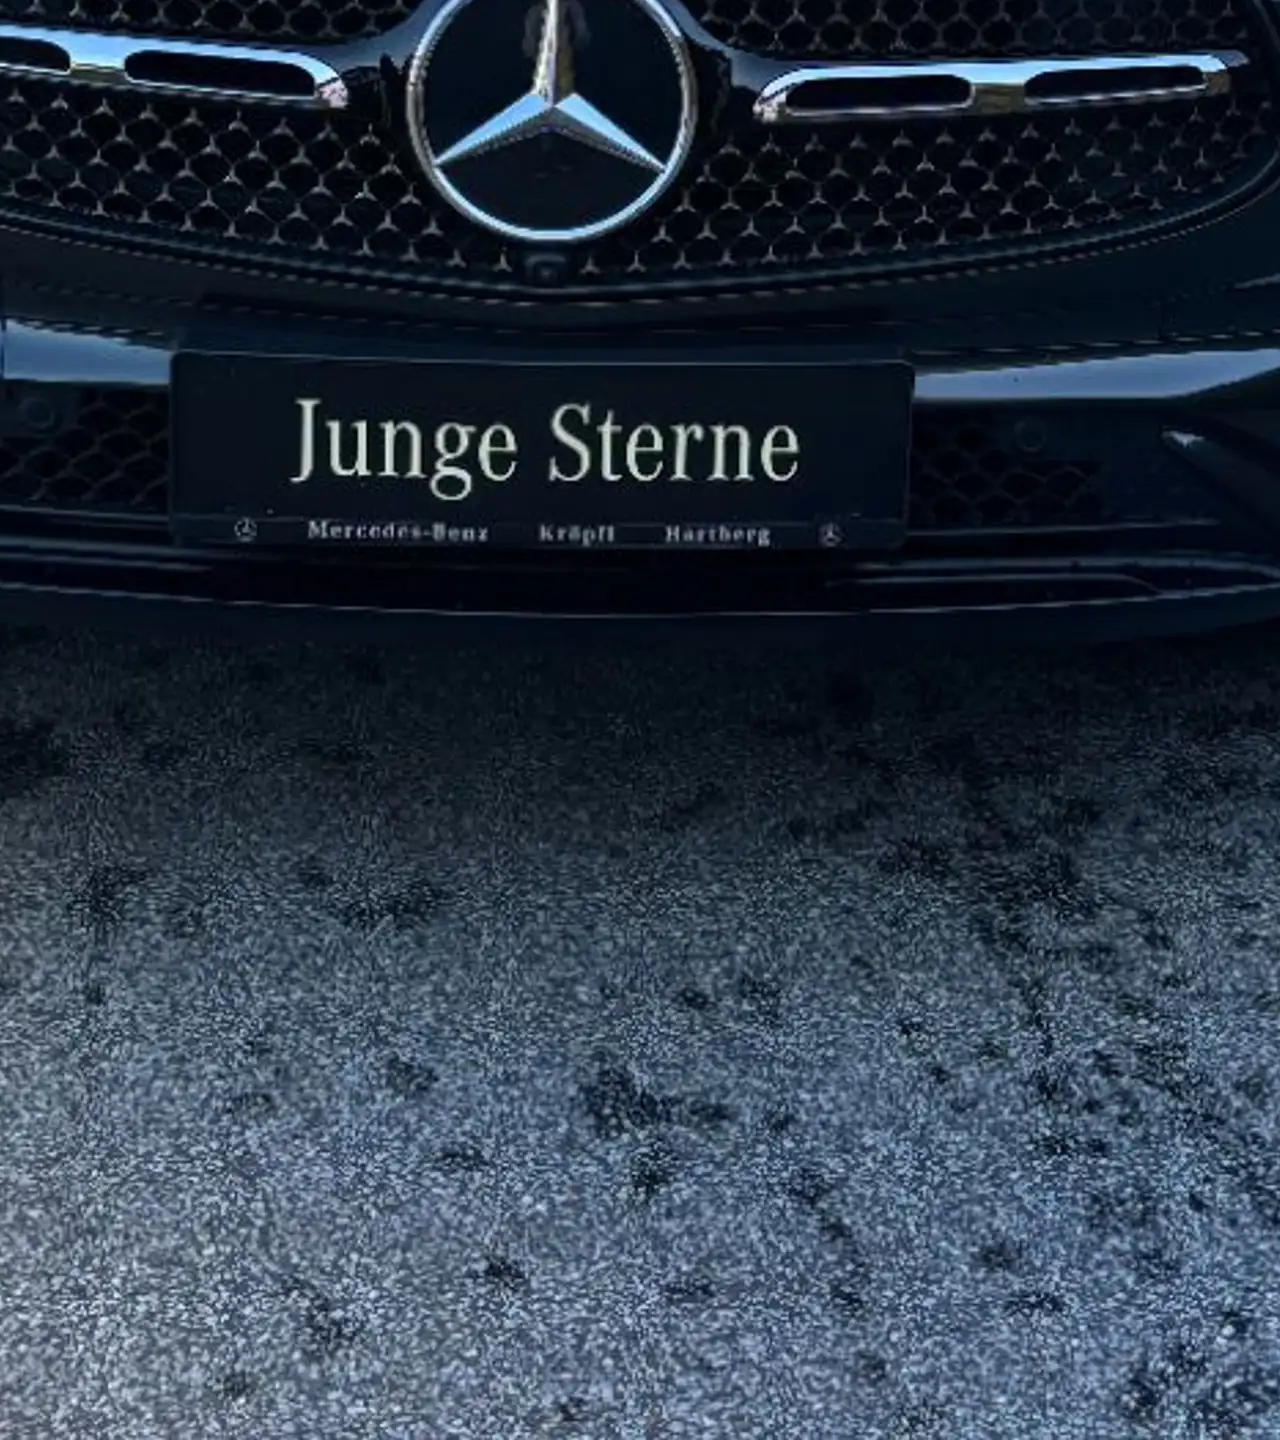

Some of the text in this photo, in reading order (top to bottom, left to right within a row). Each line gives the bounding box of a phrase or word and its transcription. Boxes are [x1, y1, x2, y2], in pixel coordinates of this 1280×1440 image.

[291, 398, 799, 501] Junge Sterne
[307, 519, 489, 542] Mercedes-Benz
[665, 524, 771, 547] Hartberg
